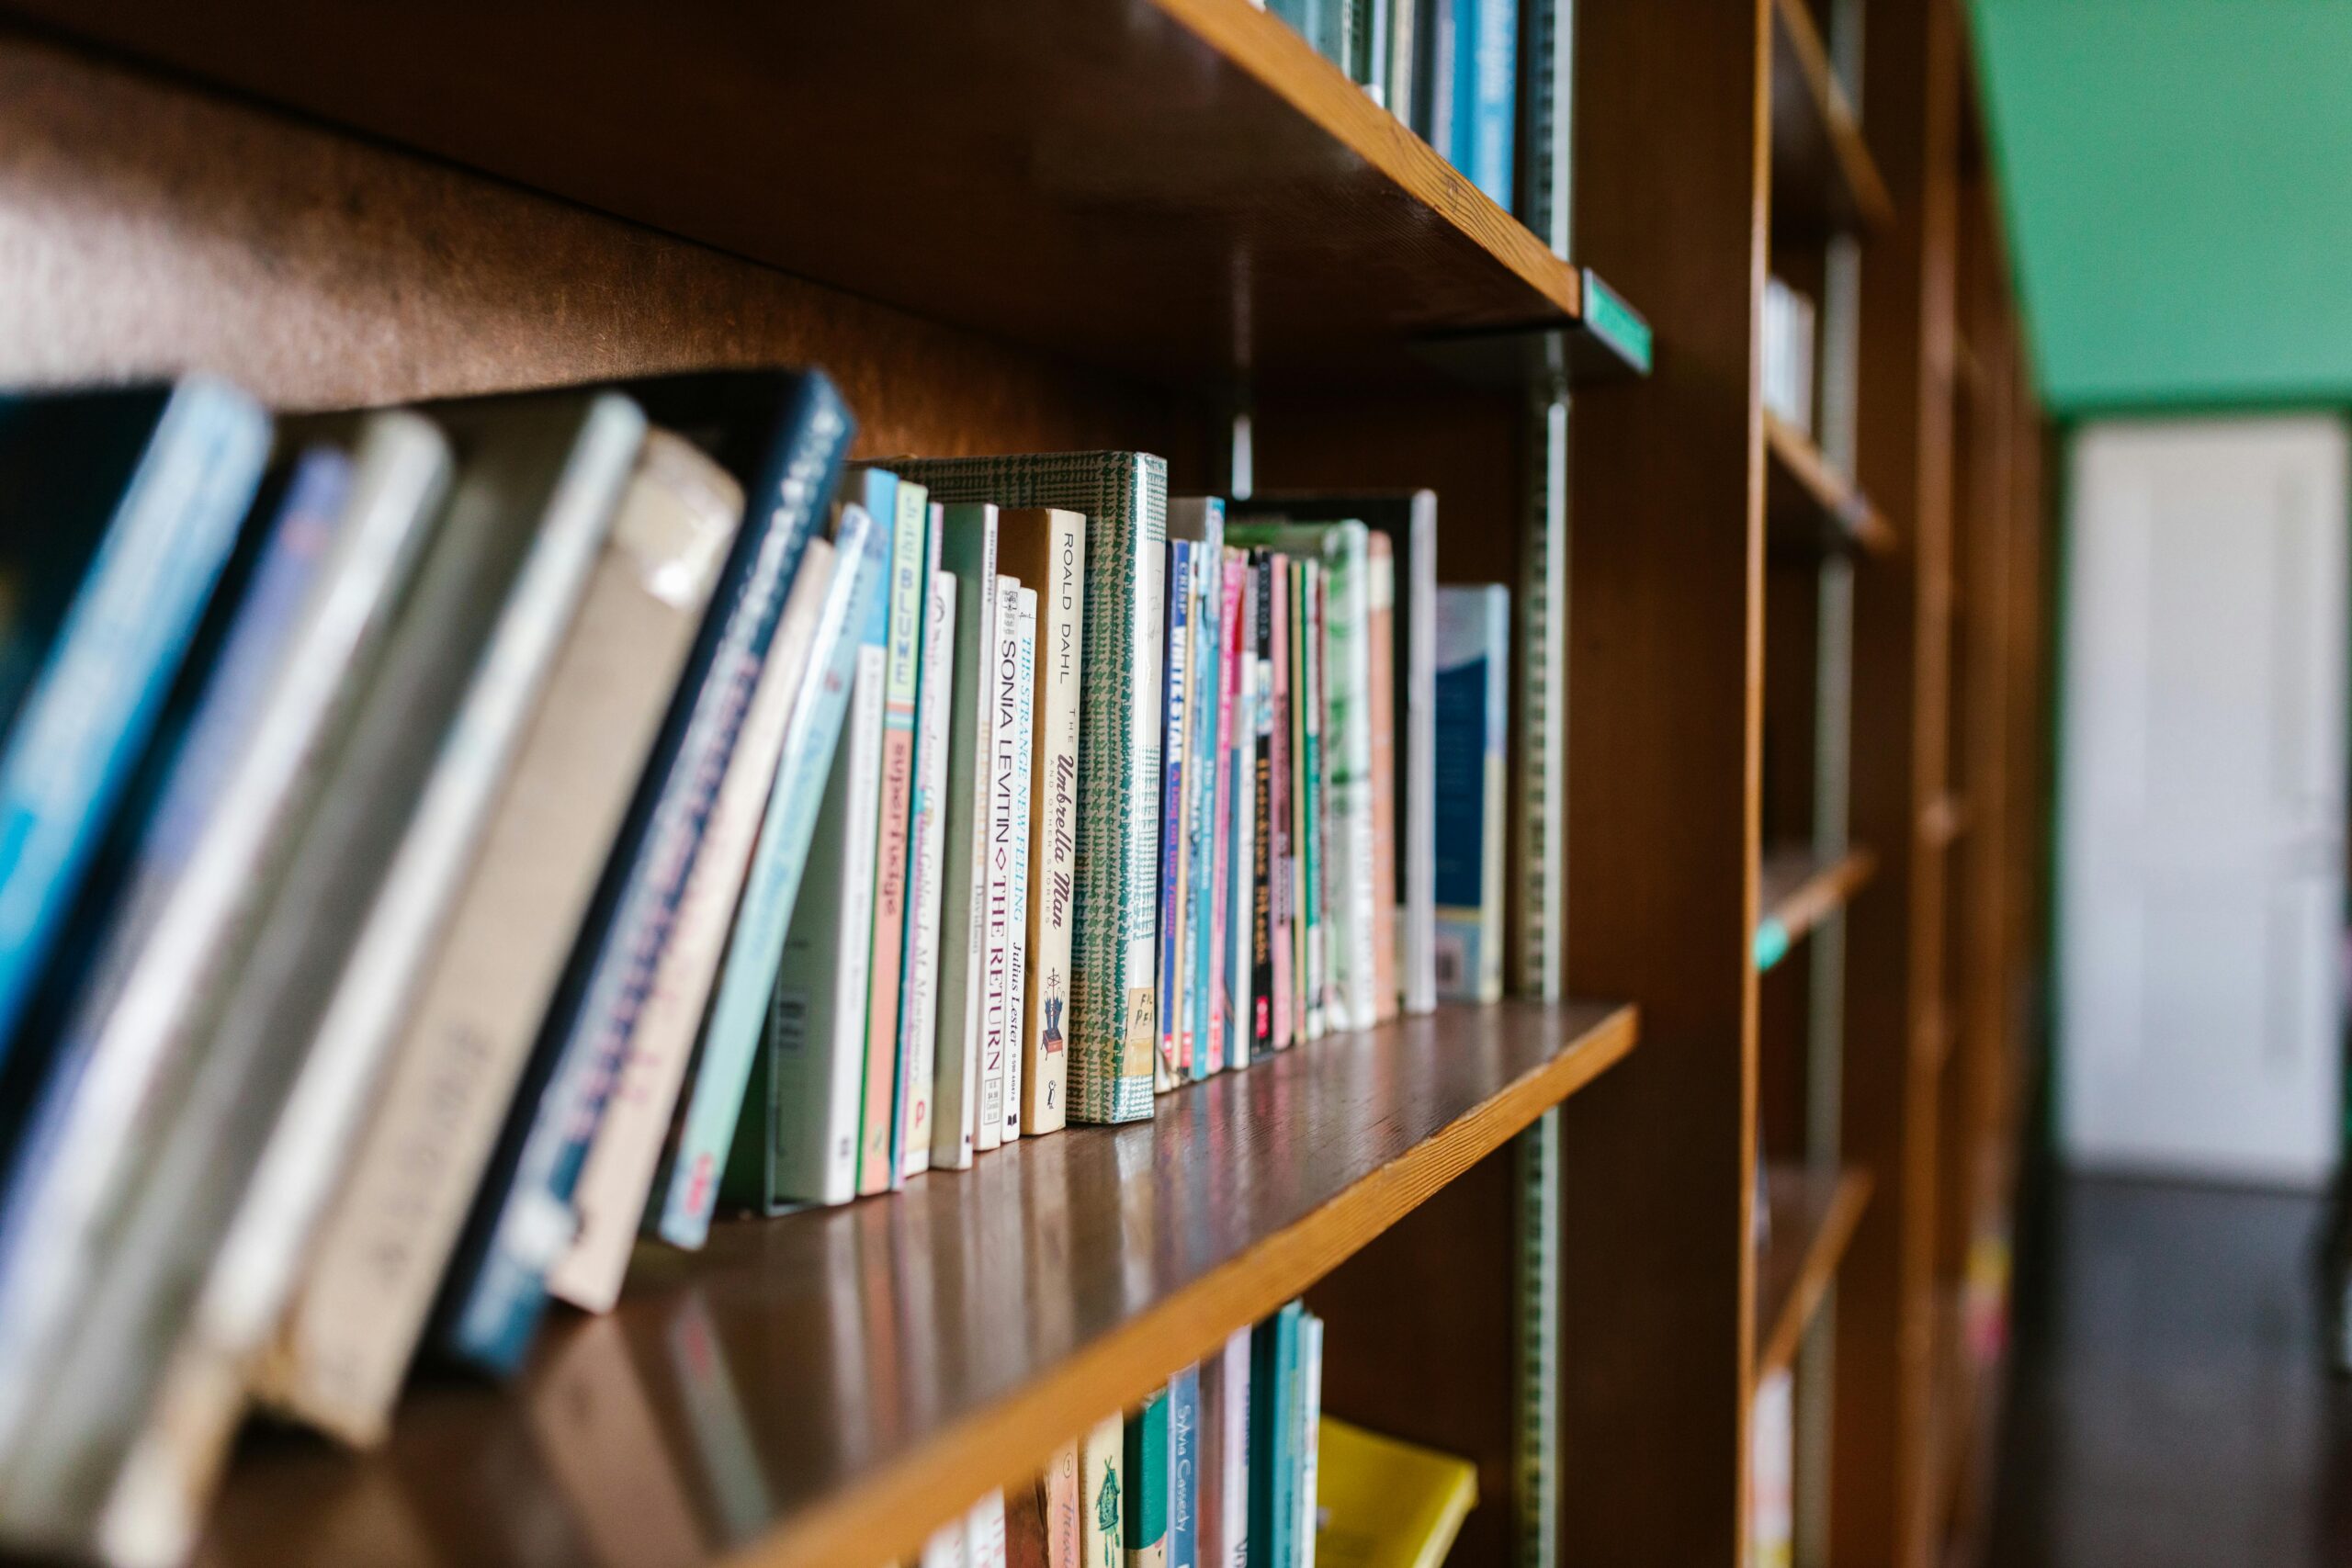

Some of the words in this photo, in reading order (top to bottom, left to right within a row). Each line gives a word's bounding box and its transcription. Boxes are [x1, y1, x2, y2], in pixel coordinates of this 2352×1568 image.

[1062, 532, 1074, 610] ROALD
[1177, 561, 1188, 615] CRISP
[1000, 640, 1016, 728] SONIA
[1021, 637, 1032, 680] THIS
[1059, 624, 1071, 684] DAHL
[1018, 685, 1031, 779] STRANGE
[1068, 708, 1076, 744] THE
[996, 740, 1013, 843] LEVITIN
[1015, 784, 1027, 833] NEW
[1053, 754, 1074, 863] Umbrella
[991, 875, 1007, 937] THE
[1013, 837, 1025, 922] FEELING
[1052, 871, 1070, 930] Man
[1011, 942, 1023, 993] Julius
[987, 948, 1006, 1071] RETURN
[1009, 997, 1022, 1046] Lester
[1177, 1404, 1192, 1455] Sylvia
[1175, 1459, 1192, 1532] Cassedy
